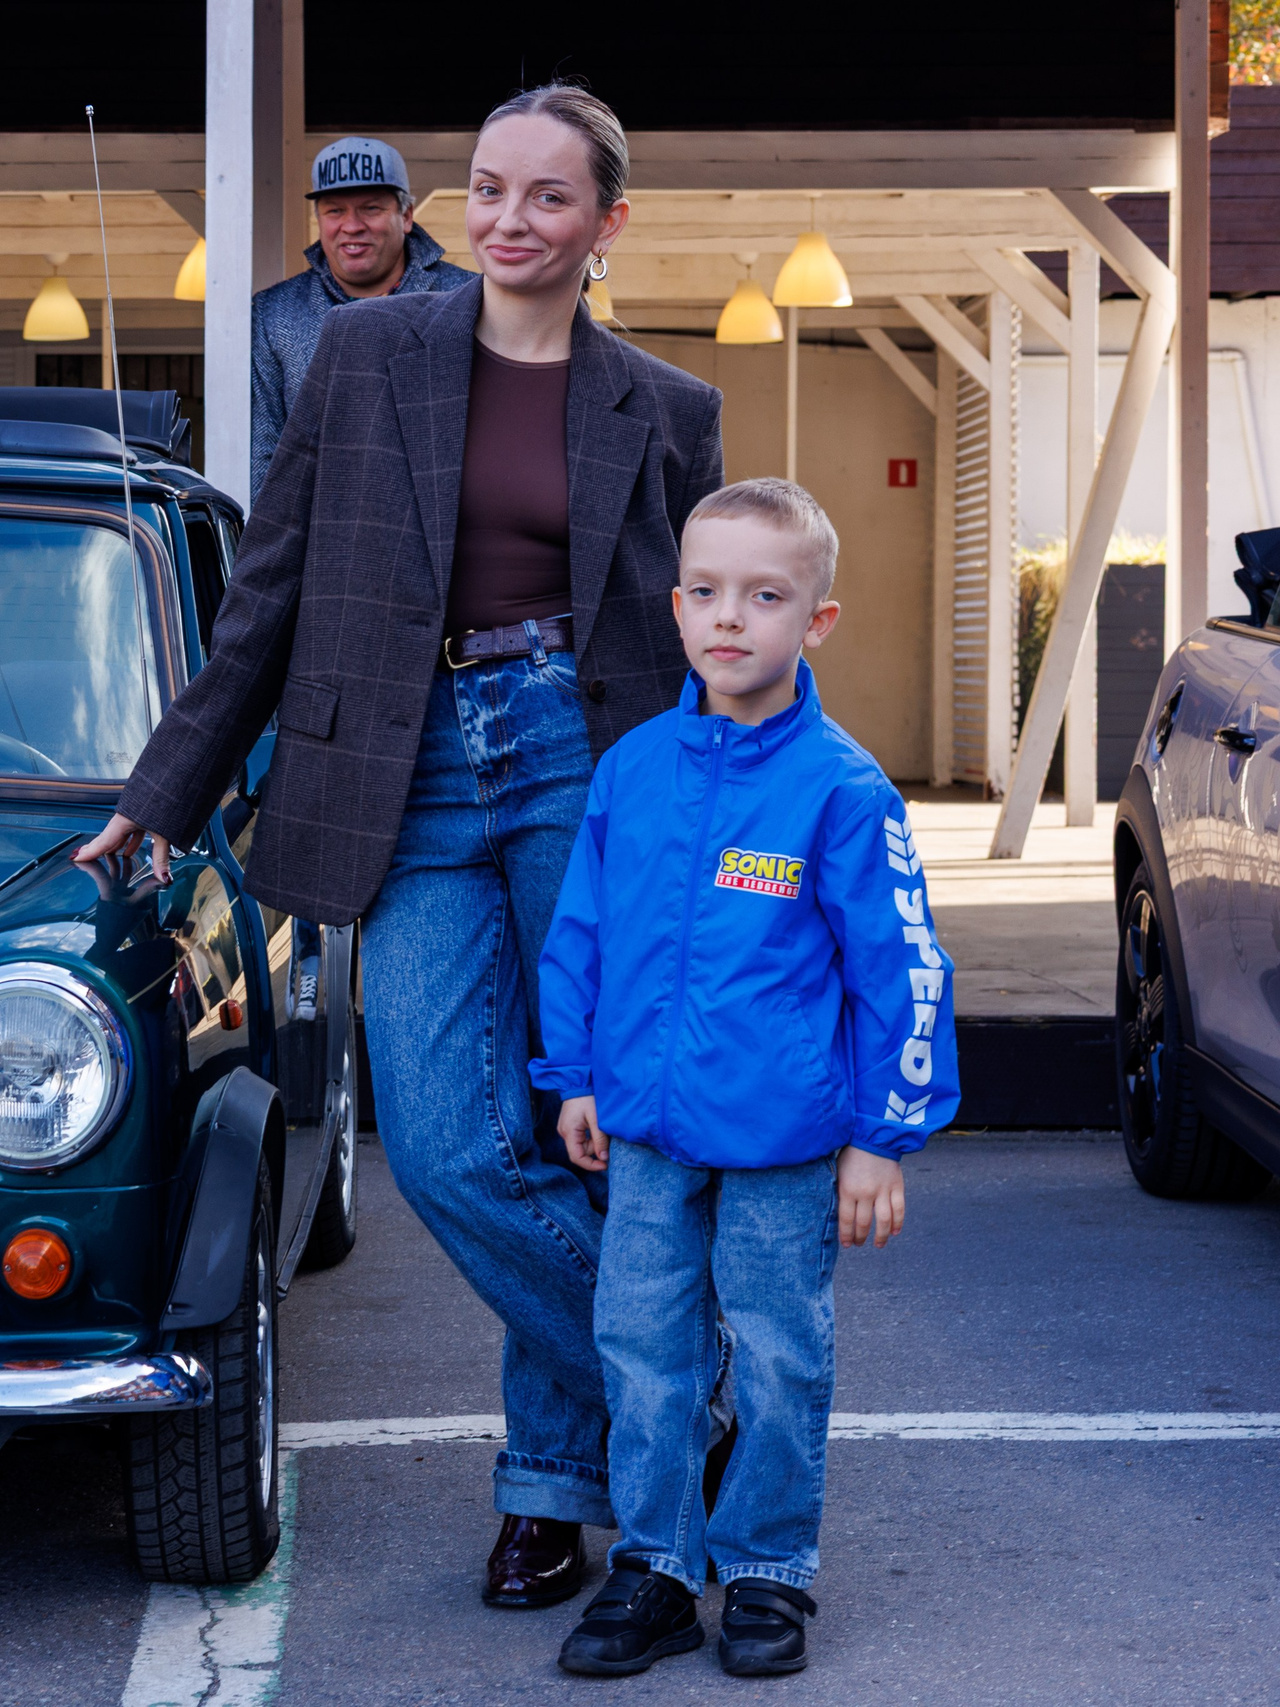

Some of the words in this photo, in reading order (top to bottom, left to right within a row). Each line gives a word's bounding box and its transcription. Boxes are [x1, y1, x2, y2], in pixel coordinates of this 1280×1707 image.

[318, 152, 385, 189] МОСКВА
[721, 850, 803, 885] SONIC
[719, 875, 739, 887] THE
[743, 878, 799, 897] HEDGEHOG
[894, 887, 944, 1086] SPEED
